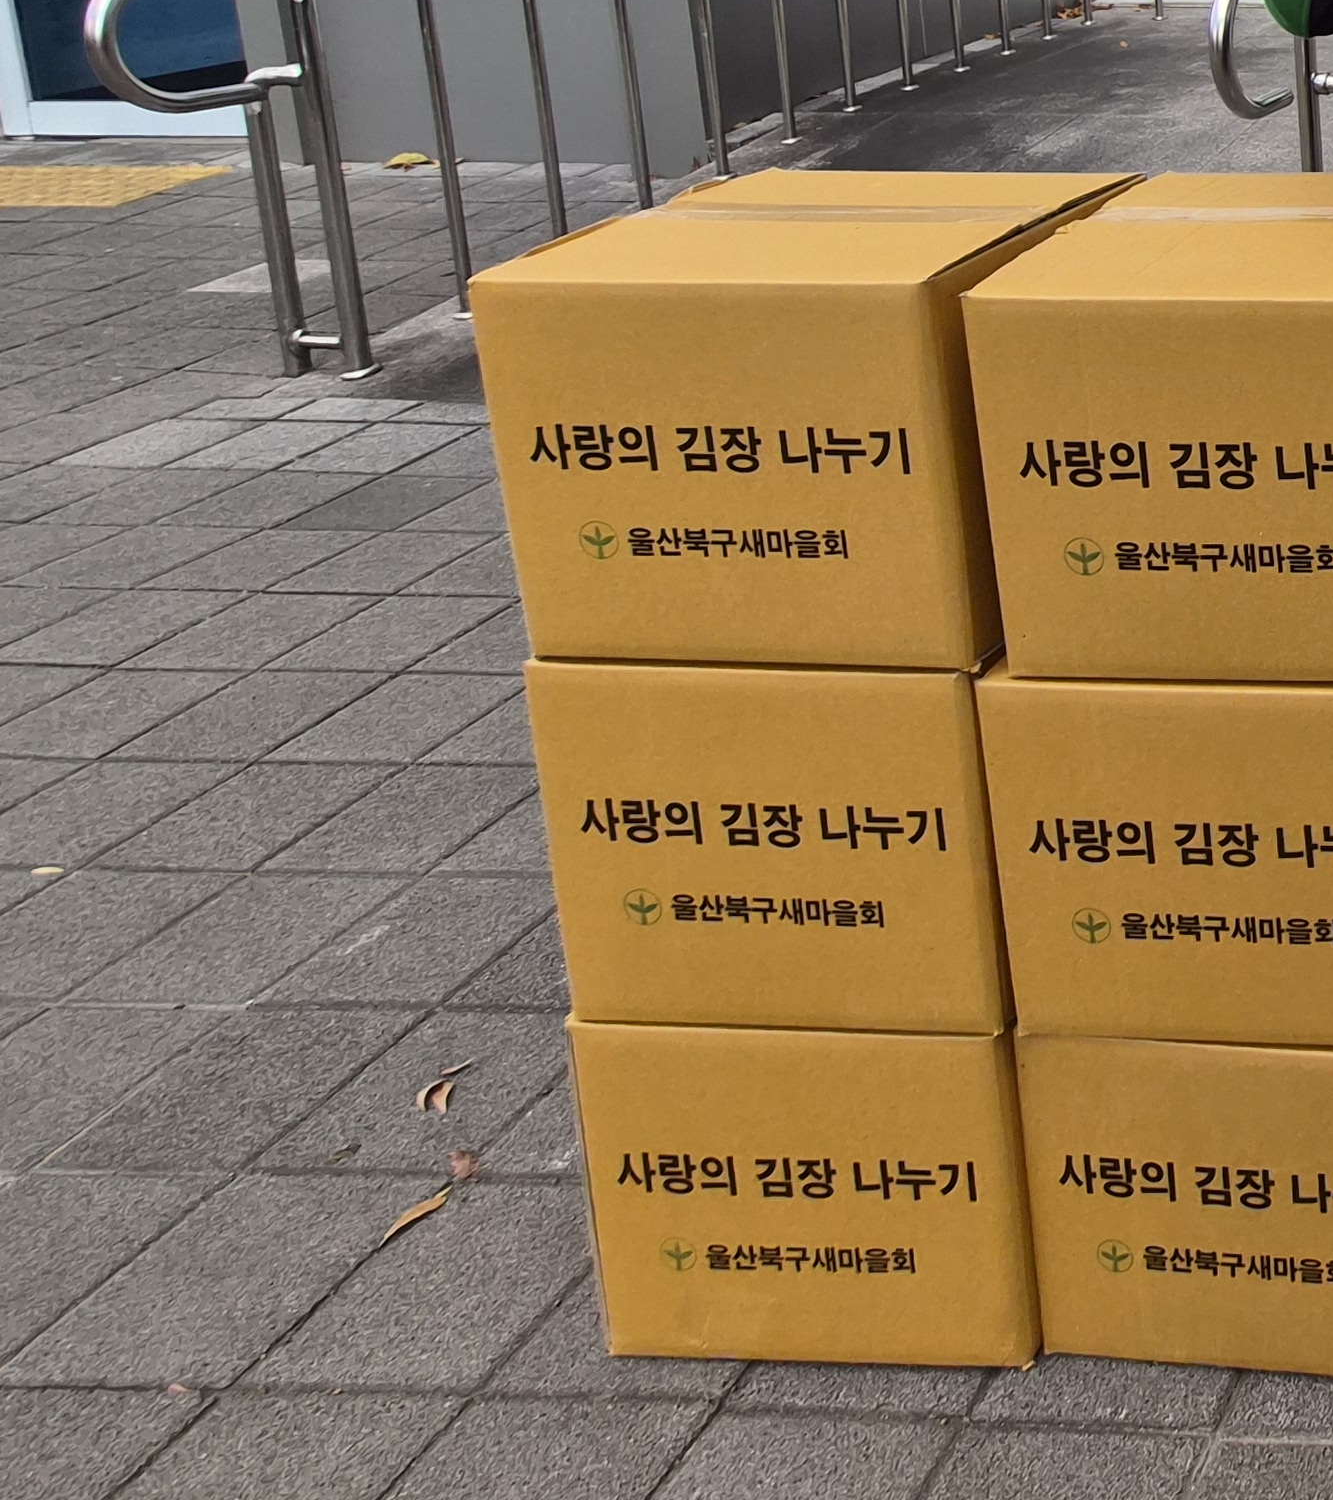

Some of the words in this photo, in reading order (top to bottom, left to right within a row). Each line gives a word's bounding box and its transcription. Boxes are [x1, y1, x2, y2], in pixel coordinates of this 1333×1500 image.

[530, 423, 659, 472] 사랑의
[675, 425, 762, 474] 김장
[778, 426, 911, 475] 나누기
[1019, 439, 1150, 489] 사랑의
[1169, 441, 1258, 490] 김장
[627, 527, 849, 560] 울산북구새마을회
[580, 797, 703, 845] 사랑의
[720, 802, 803, 849] 김장
[818, 805, 947, 852] 나누기
[1028, 817, 1156, 865] 사랑의
[1174, 822, 1260, 868] 김장
[671, 894, 885, 928] 울산북구새마을회
[617, 1151, 738, 1197] 사랑의
[754, 1157, 837, 1199] 김장
[852, 1159, 978, 1202] 나누기
[1058, 1153, 1177, 1203] 사랑의
[1194, 1165, 1276, 1210] 김장
[705, 1244, 916, 1274] 울산북구새마을회
